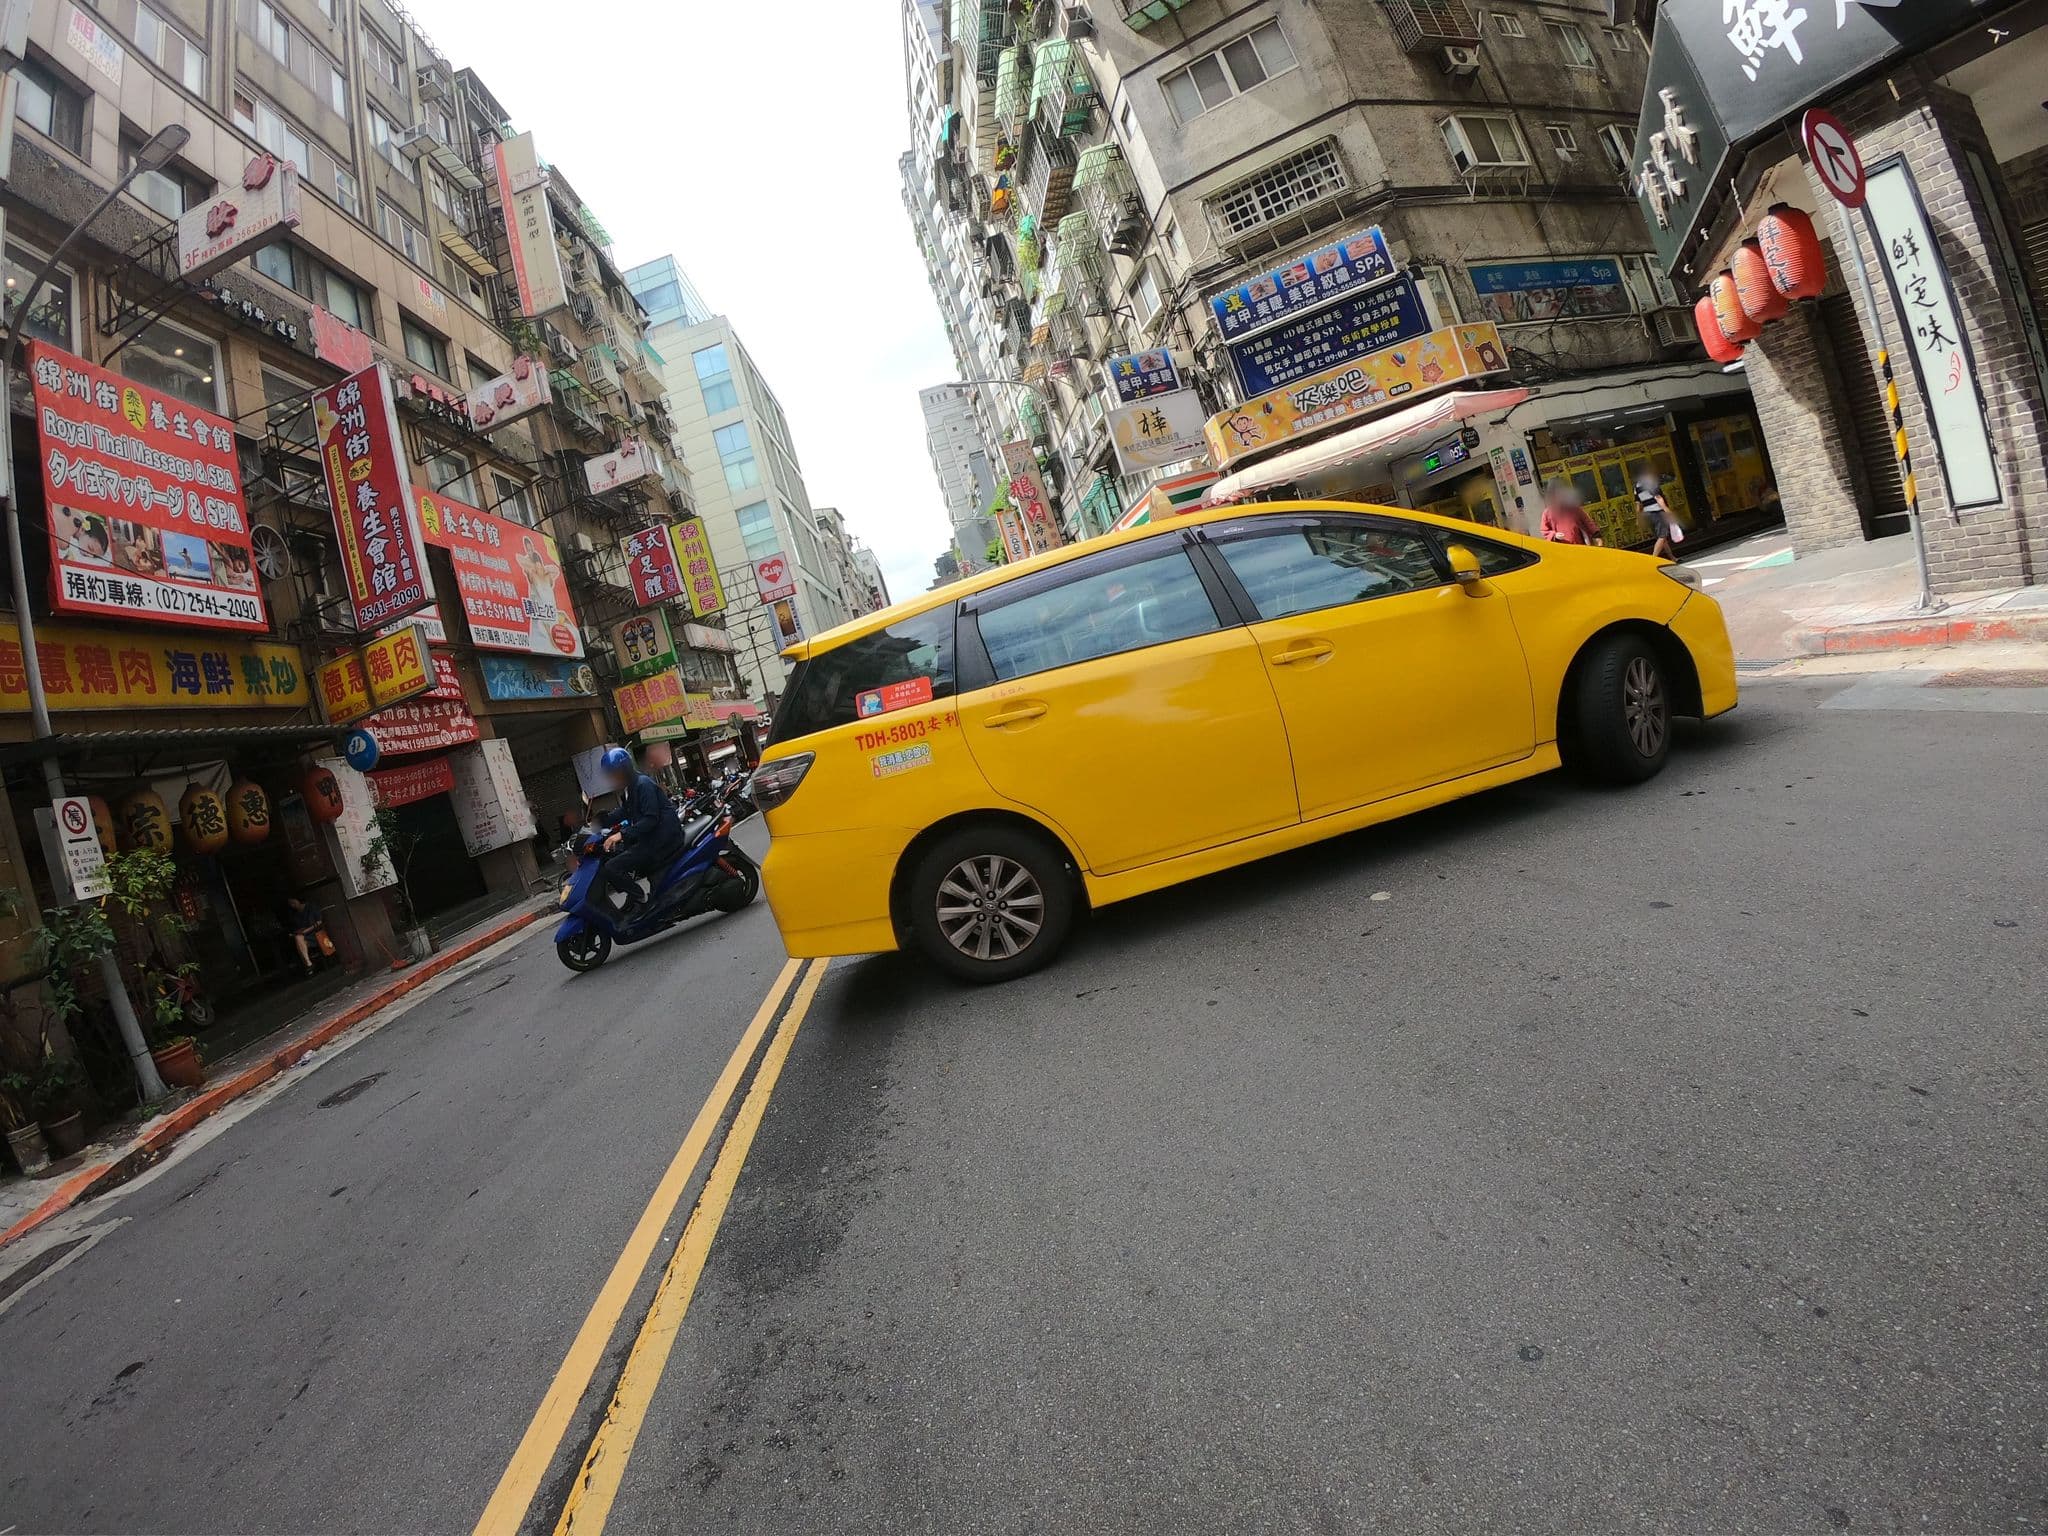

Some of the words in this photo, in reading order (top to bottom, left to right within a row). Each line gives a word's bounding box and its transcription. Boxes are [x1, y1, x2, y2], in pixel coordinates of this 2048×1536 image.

[185, 248, 200, 269] 3F
[1592, 266, 1612, 279] Spa
[1892, 228, 1957, 353] 鮮定味
[35, 356, 118, 414] 錦洲街
[125, 389, 146, 427] 泰式
[150, 400, 232, 453] 養生會館
[1134, 390, 1146, 398] 2F
[44, 409, 92, 450] Royal
[94, 426, 129, 461] Thai
[131, 439, 193, 480] Massage
[196, 460, 208, 484] &
[208, 464, 237, 494] SPA
[49, 449, 184, 517] タイ式マッサージ
[187, 491, 205, 524] &
[205, 497, 243, 533] SPA
[337, 382, 370, 460] 錦洲街
[356, 481, 397, 595] 養生會館
[443, 506, 500, 547] 養生會館
[628, 531, 664, 558] 泰式
[1006, 521, 1021, 555] Holiday
[155, 587, 258, 620] (02)2541-2090
[360, 585, 421, 624] 2541-2090
[165, 649, 234, 695] 海鮮
[240, 654, 297, 695] 熱炒
[855, 720, 926, 751] TDH-5803
